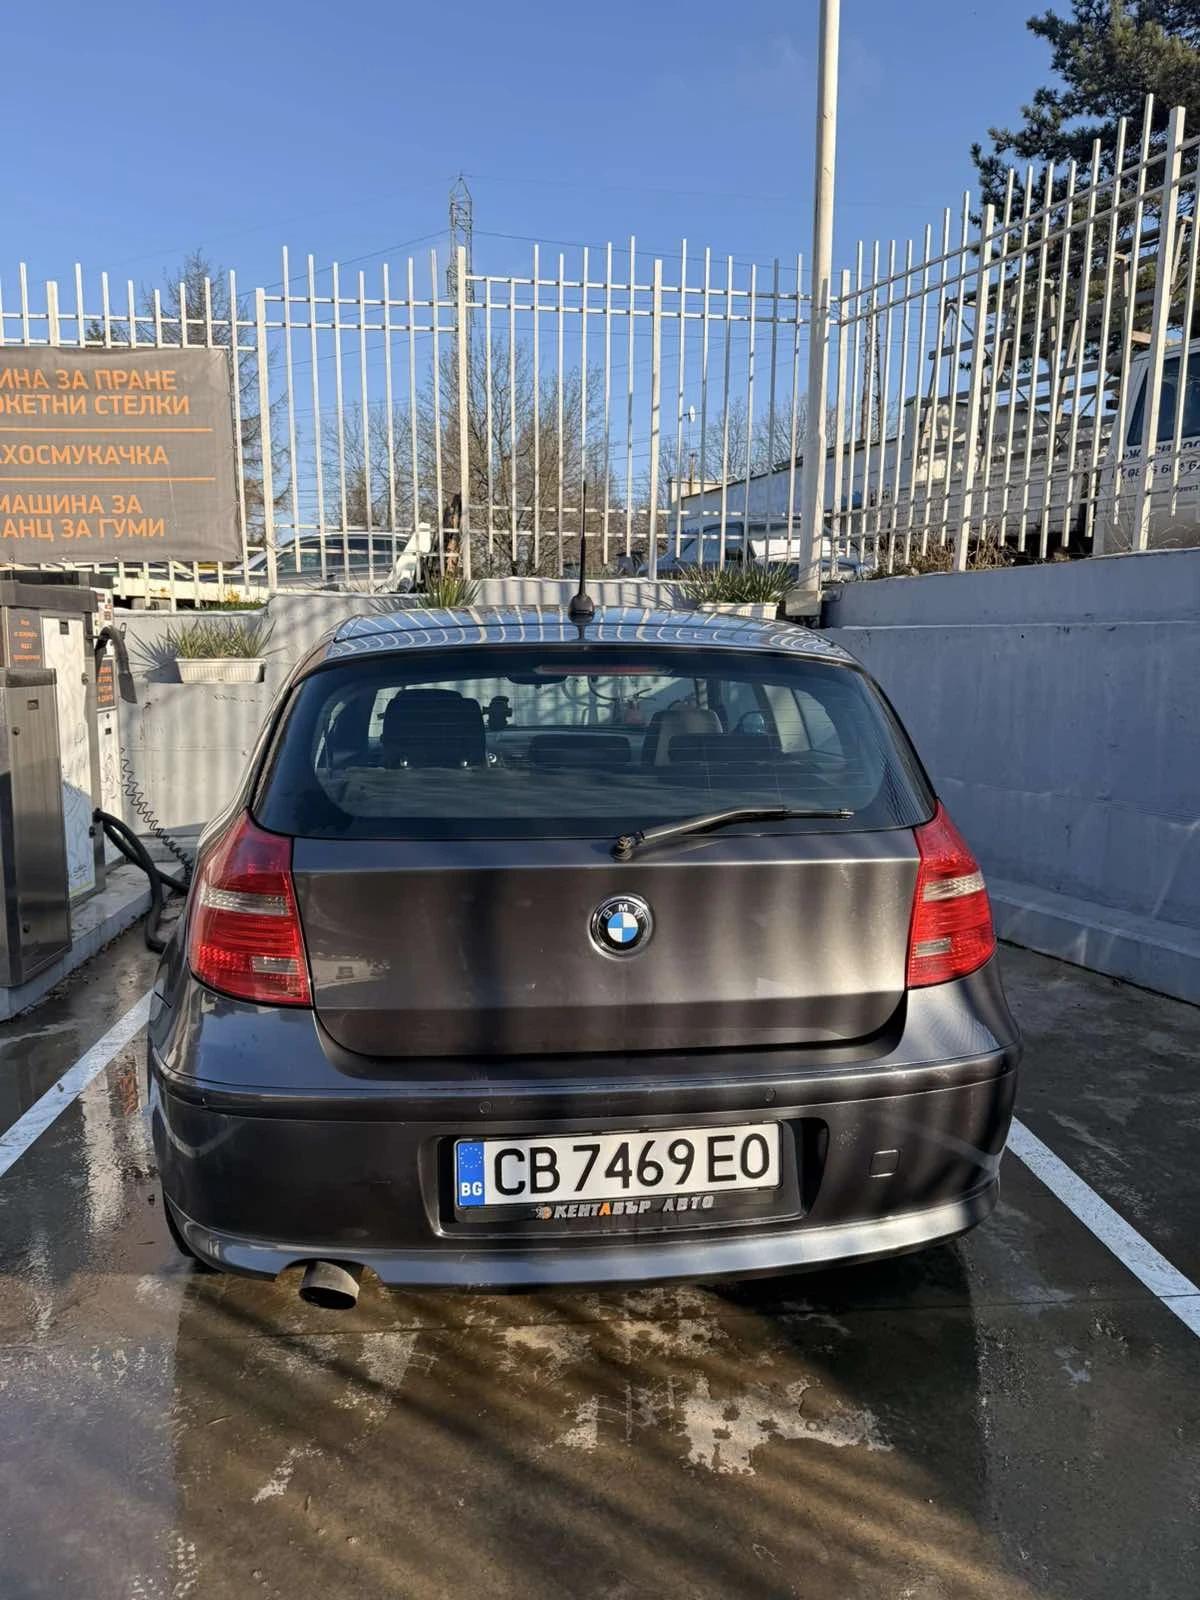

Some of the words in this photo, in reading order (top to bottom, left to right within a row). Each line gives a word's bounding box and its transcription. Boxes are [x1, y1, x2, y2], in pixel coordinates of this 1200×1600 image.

[55, 368, 89, 391] ЗА
[94, 369, 177, 392] ПРАНЕ
[94, 395, 191, 416] СТЕЛКИ
[0, 444, 170, 465] ХОСМУКАЧКА
[111, 495, 144, 514] ЗА
[0, 518, 55, 542] АНЦ
[60, 518, 92, 539] ЗА
[99, 518, 165, 538] ГУМИ
[602, 903, 644, 920] BMW
[493, 1146, 561, 1196] CB
[572, 1138, 696, 1192] 7469
[460, 1181, 483, 1198] BG
[662, 1195, 715, 1212] АВТО
